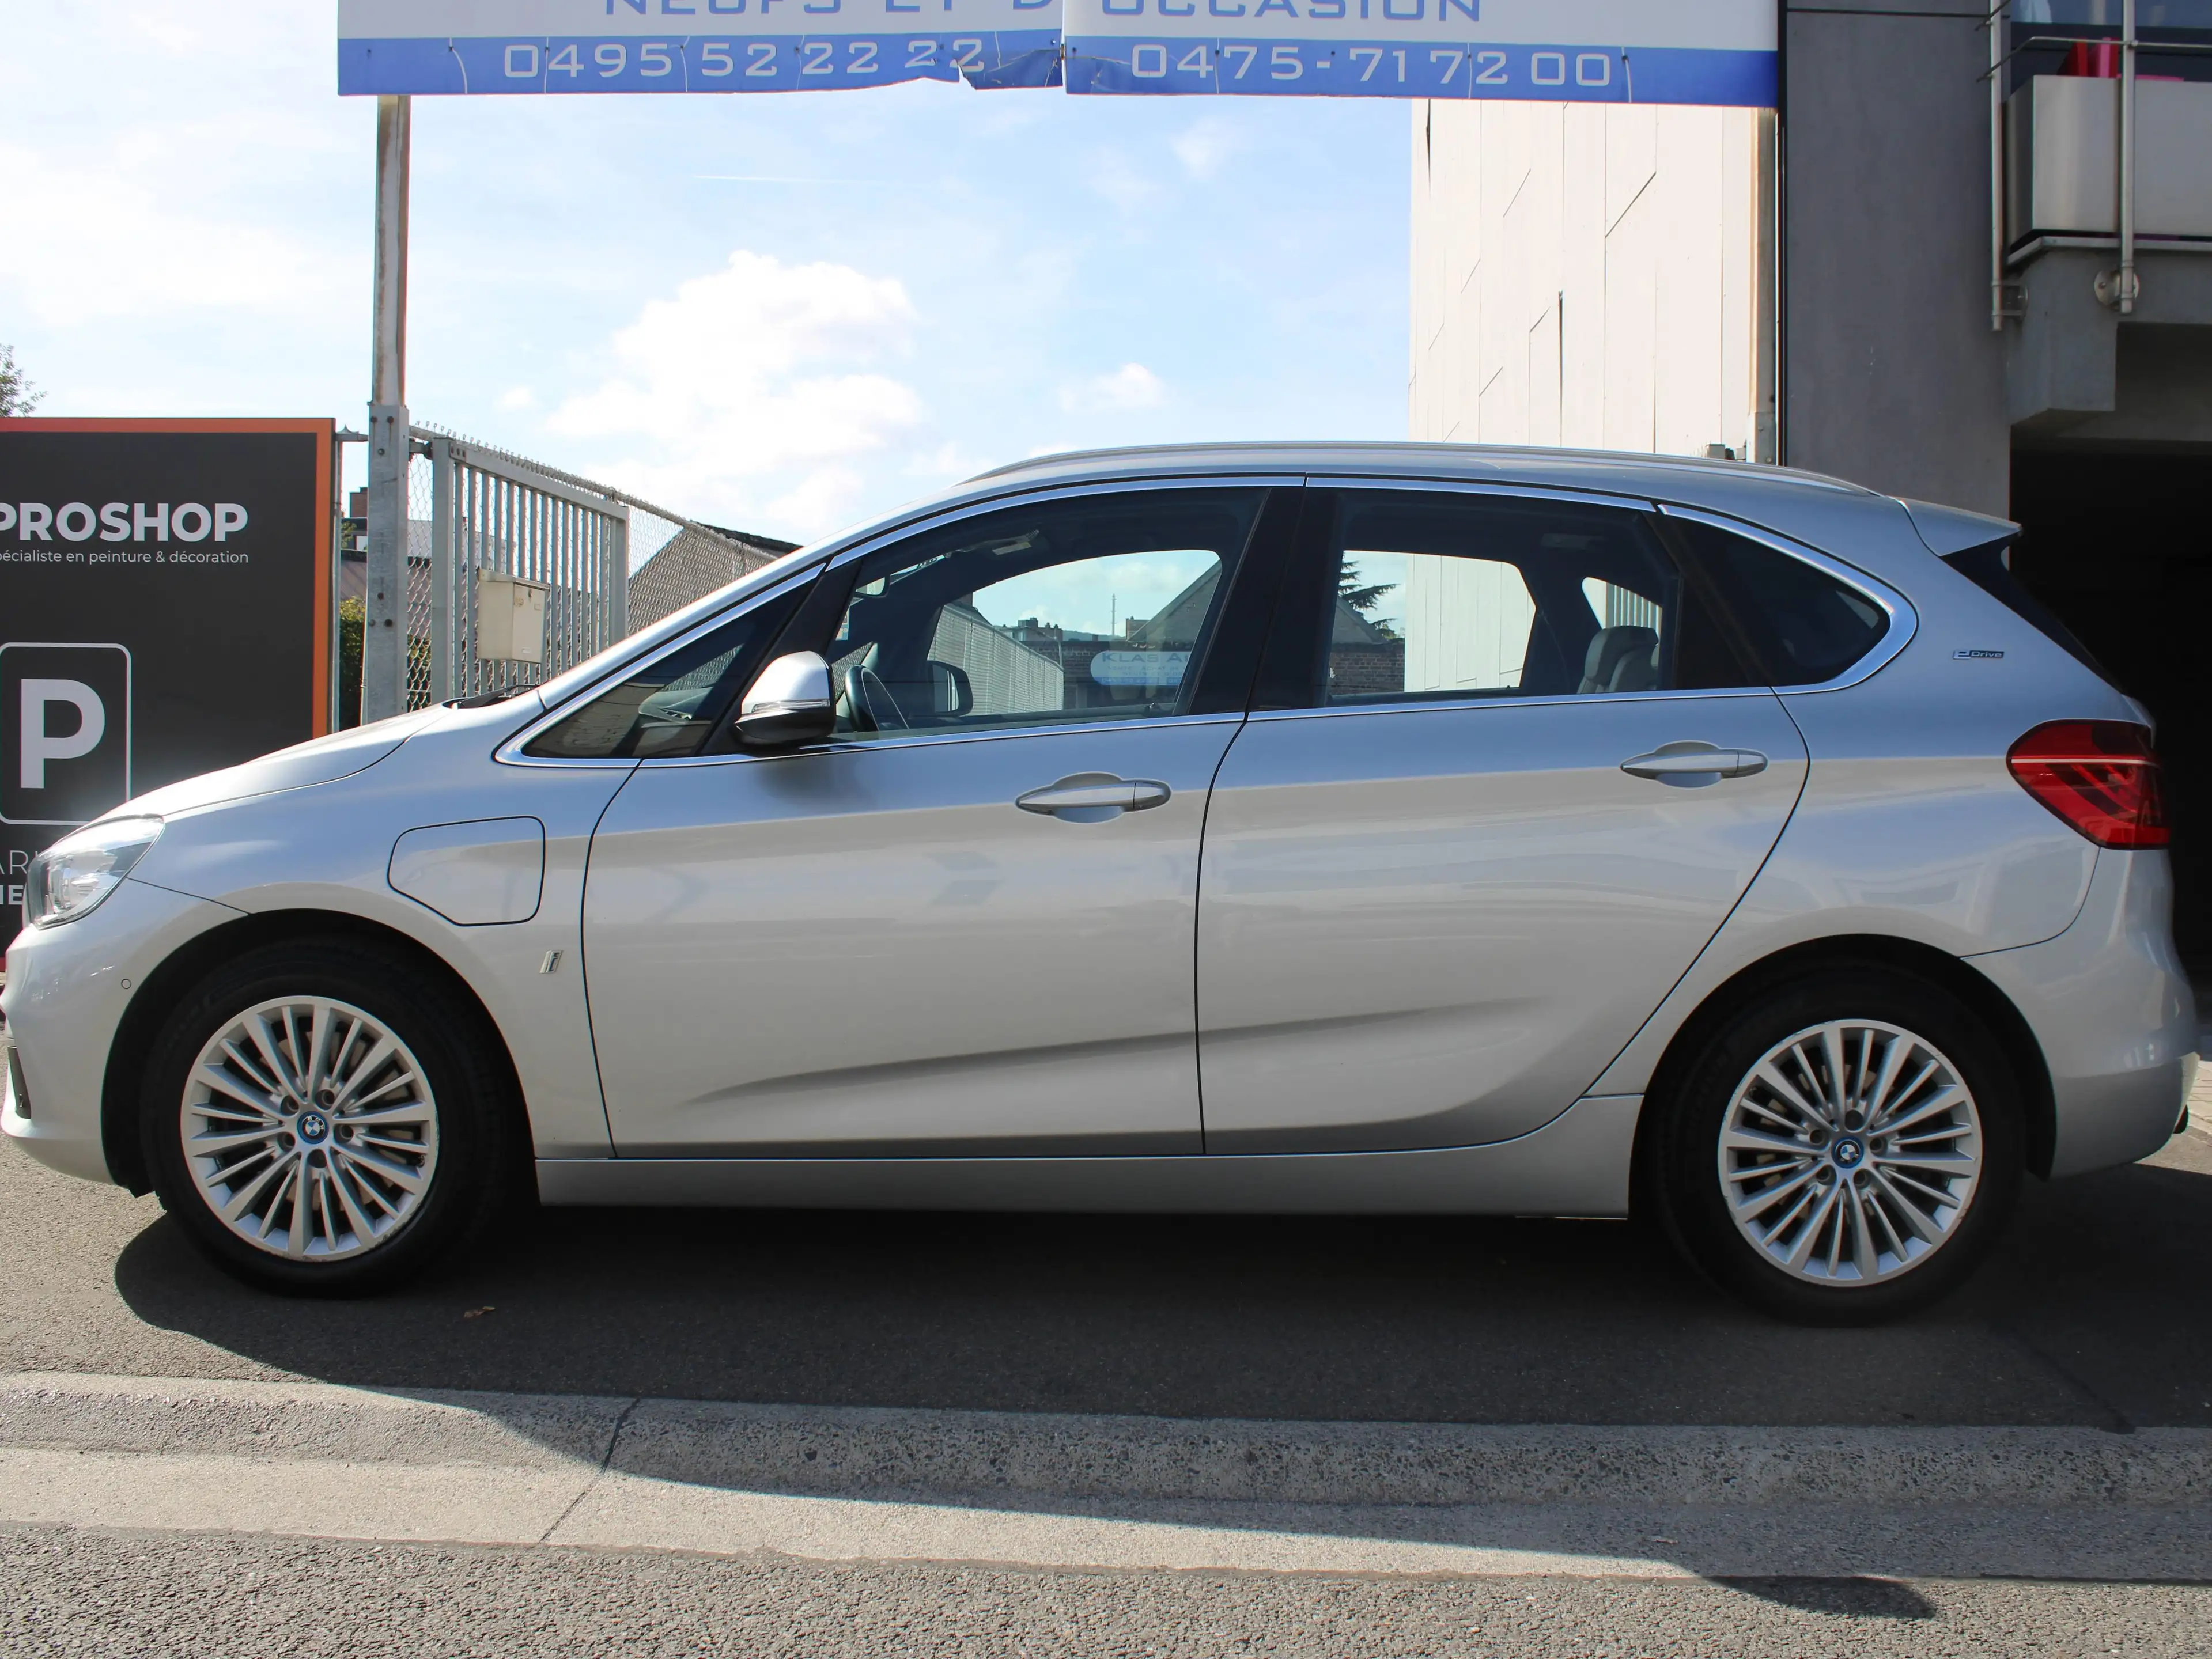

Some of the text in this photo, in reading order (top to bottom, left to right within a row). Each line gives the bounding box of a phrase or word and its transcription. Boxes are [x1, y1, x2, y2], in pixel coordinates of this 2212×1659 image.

[504, 39, 985, 77] 0495 52 22 22
[1430, 50, 1508, 84] 72
[1531, 52, 1610, 86] 00
[66, 552, 84, 562] en
[89, 550, 152, 565] peinture
[155, 551, 165, 563] &
[169, 550, 248, 563] décoration
[20, 679, 105, 789] P
